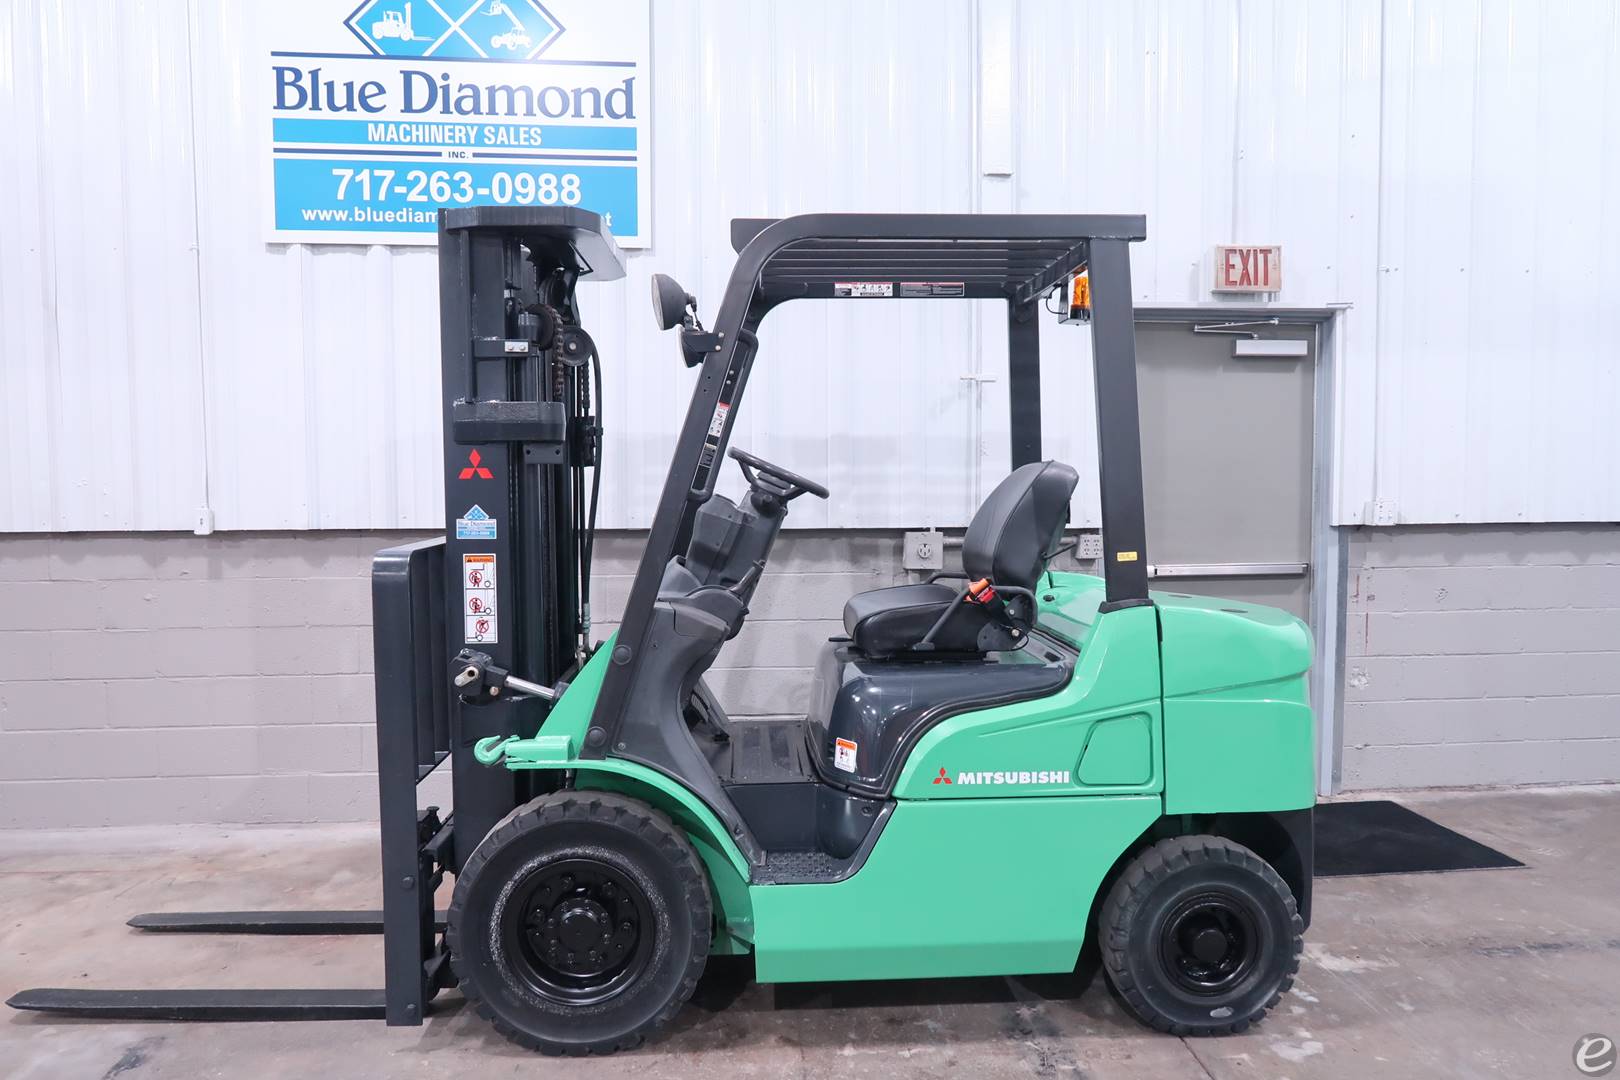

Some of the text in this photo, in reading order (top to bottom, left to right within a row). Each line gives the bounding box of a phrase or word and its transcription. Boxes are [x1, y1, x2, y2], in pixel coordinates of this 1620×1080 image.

[272, 66, 636, 120] Blue Diamond
[367, 122, 543, 146] MACHINERY SALES
[448, 150, 469, 159] INC.
[332, 168, 582, 206] 717-263-0988
[1224, 248, 1273, 287] EXIT
[957, 770, 1070, 785] MITSUBISHI
